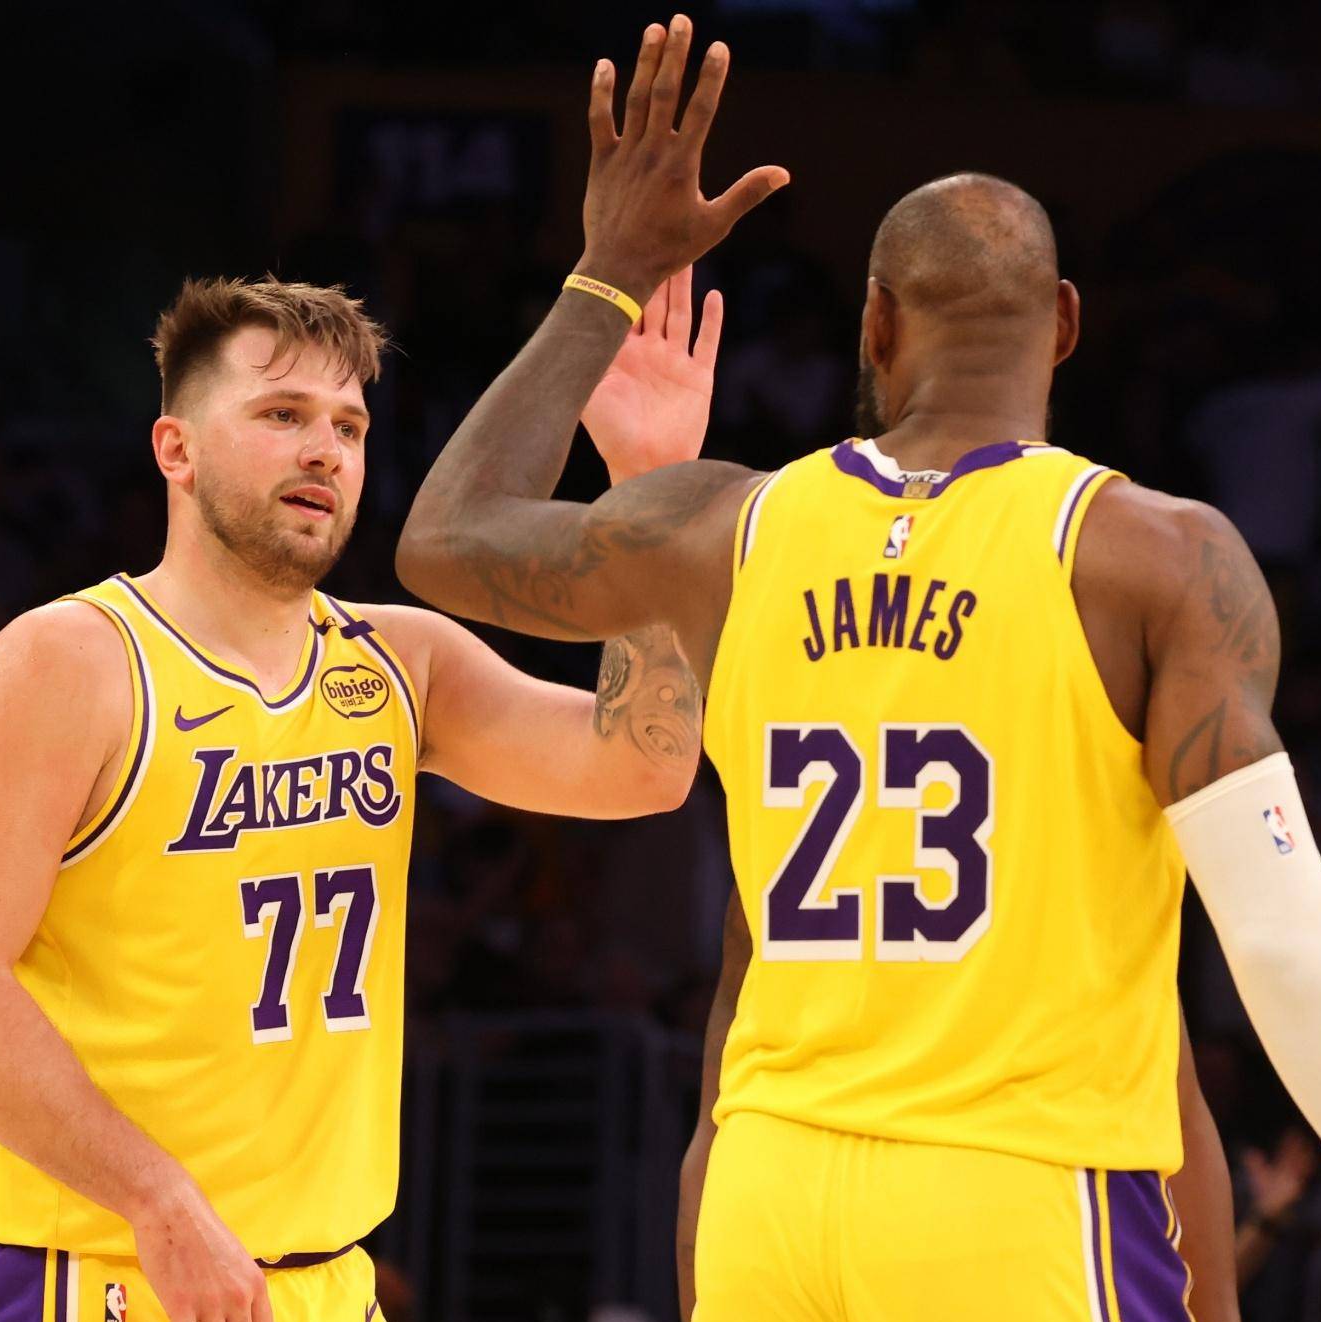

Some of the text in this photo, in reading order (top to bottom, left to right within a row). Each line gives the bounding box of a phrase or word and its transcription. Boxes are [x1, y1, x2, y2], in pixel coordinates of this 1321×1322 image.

[898, 474, 940, 484] NIKE
[803, 572, 977, 663] JAMES
[325, 679, 384, 699] bibigo
[163, 743, 401, 857] LAKERS
[762, 722, 995, 962] 23
[238, 863, 380, 1045] 77
